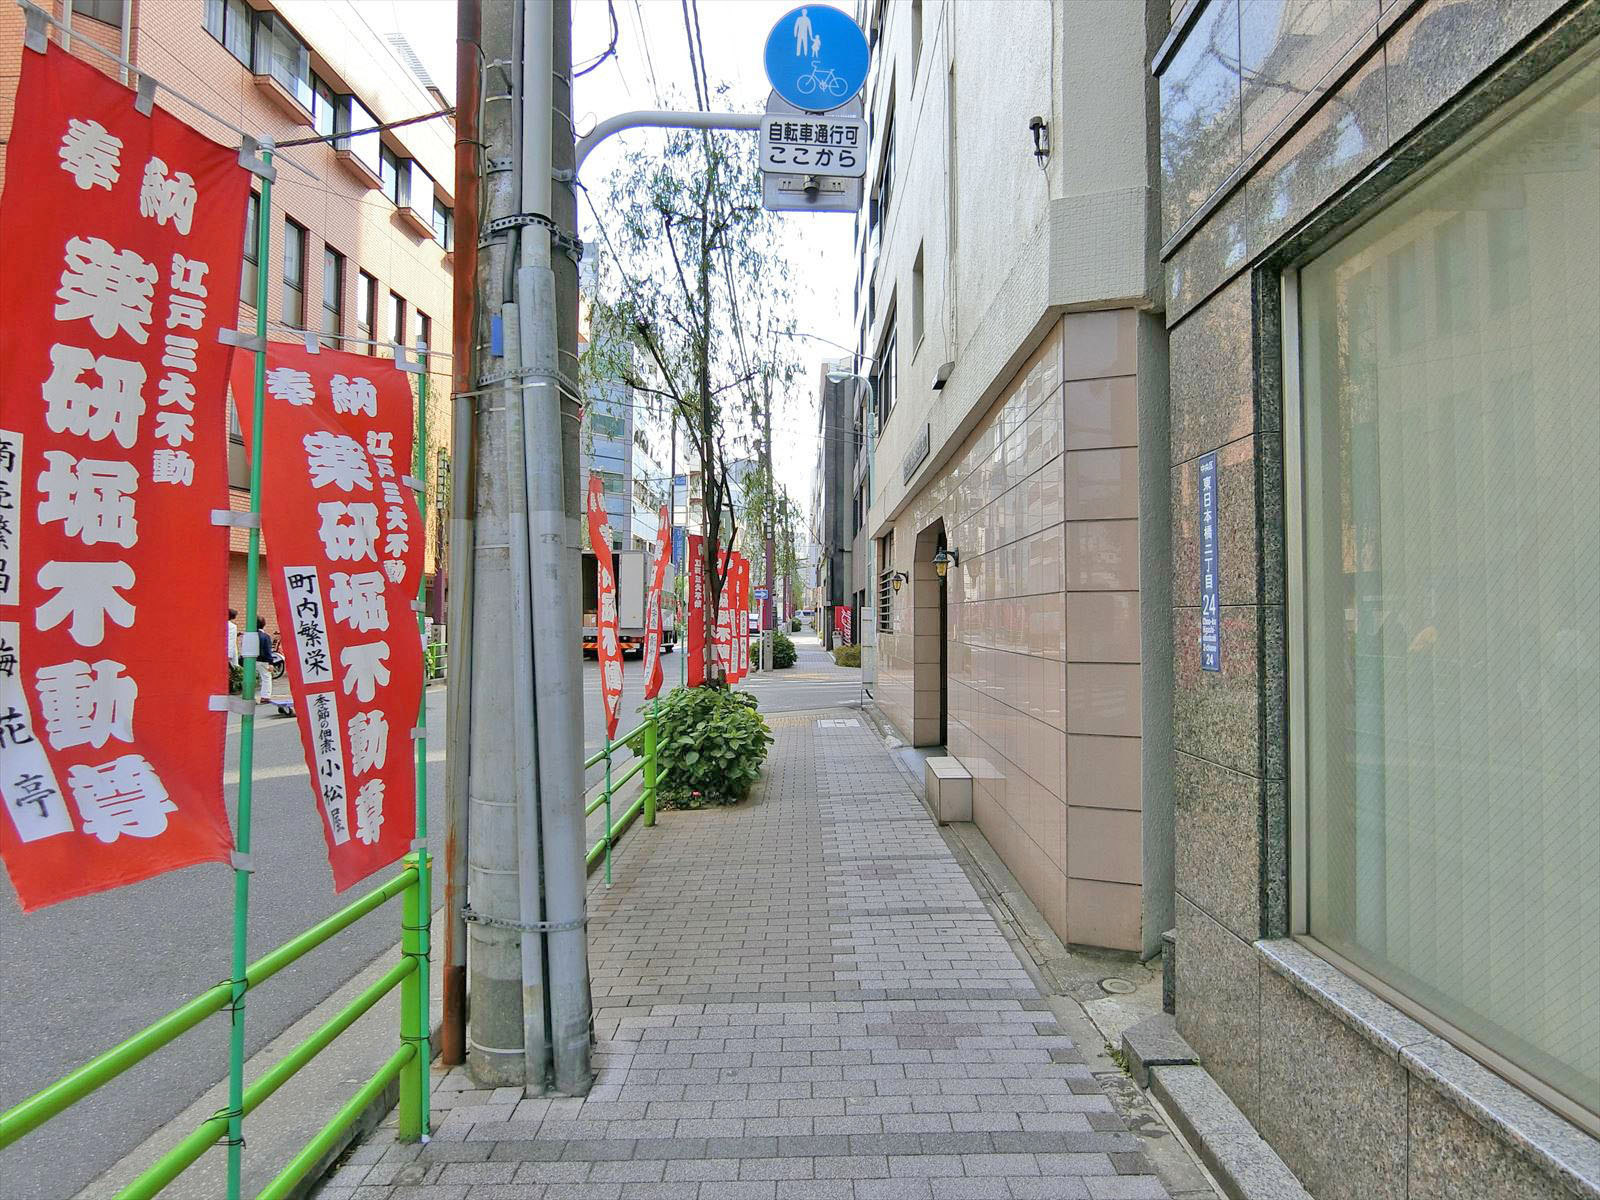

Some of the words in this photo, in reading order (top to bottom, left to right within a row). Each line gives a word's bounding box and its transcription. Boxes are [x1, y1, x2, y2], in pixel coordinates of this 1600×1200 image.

[769, 122, 859, 145] 自転車通行可
[770, 146, 856, 168] ここから
[58, 118, 198, 236] 奉納
[153, 253, 208, 487] 江戸三大不動
[266, 367, 378, 418] 奉納
[367, 430, 409, 584] 江戸三大不動
[1200, 460, 1214, 473] 中央区
[36, 236, 178, 844] 薬研堀不動尊
[1202, 475, 1214, 589] 東日本橋二丁目
[287, 573, 329, 676] 町内繁栄
[303, 430, 391, 846] 薬研堀不動尊
[1202, 593, 1216, 616] 24
[1206, 653, 1214, 666] 24
[313, 694, 336, 755] 季節の佃煮
